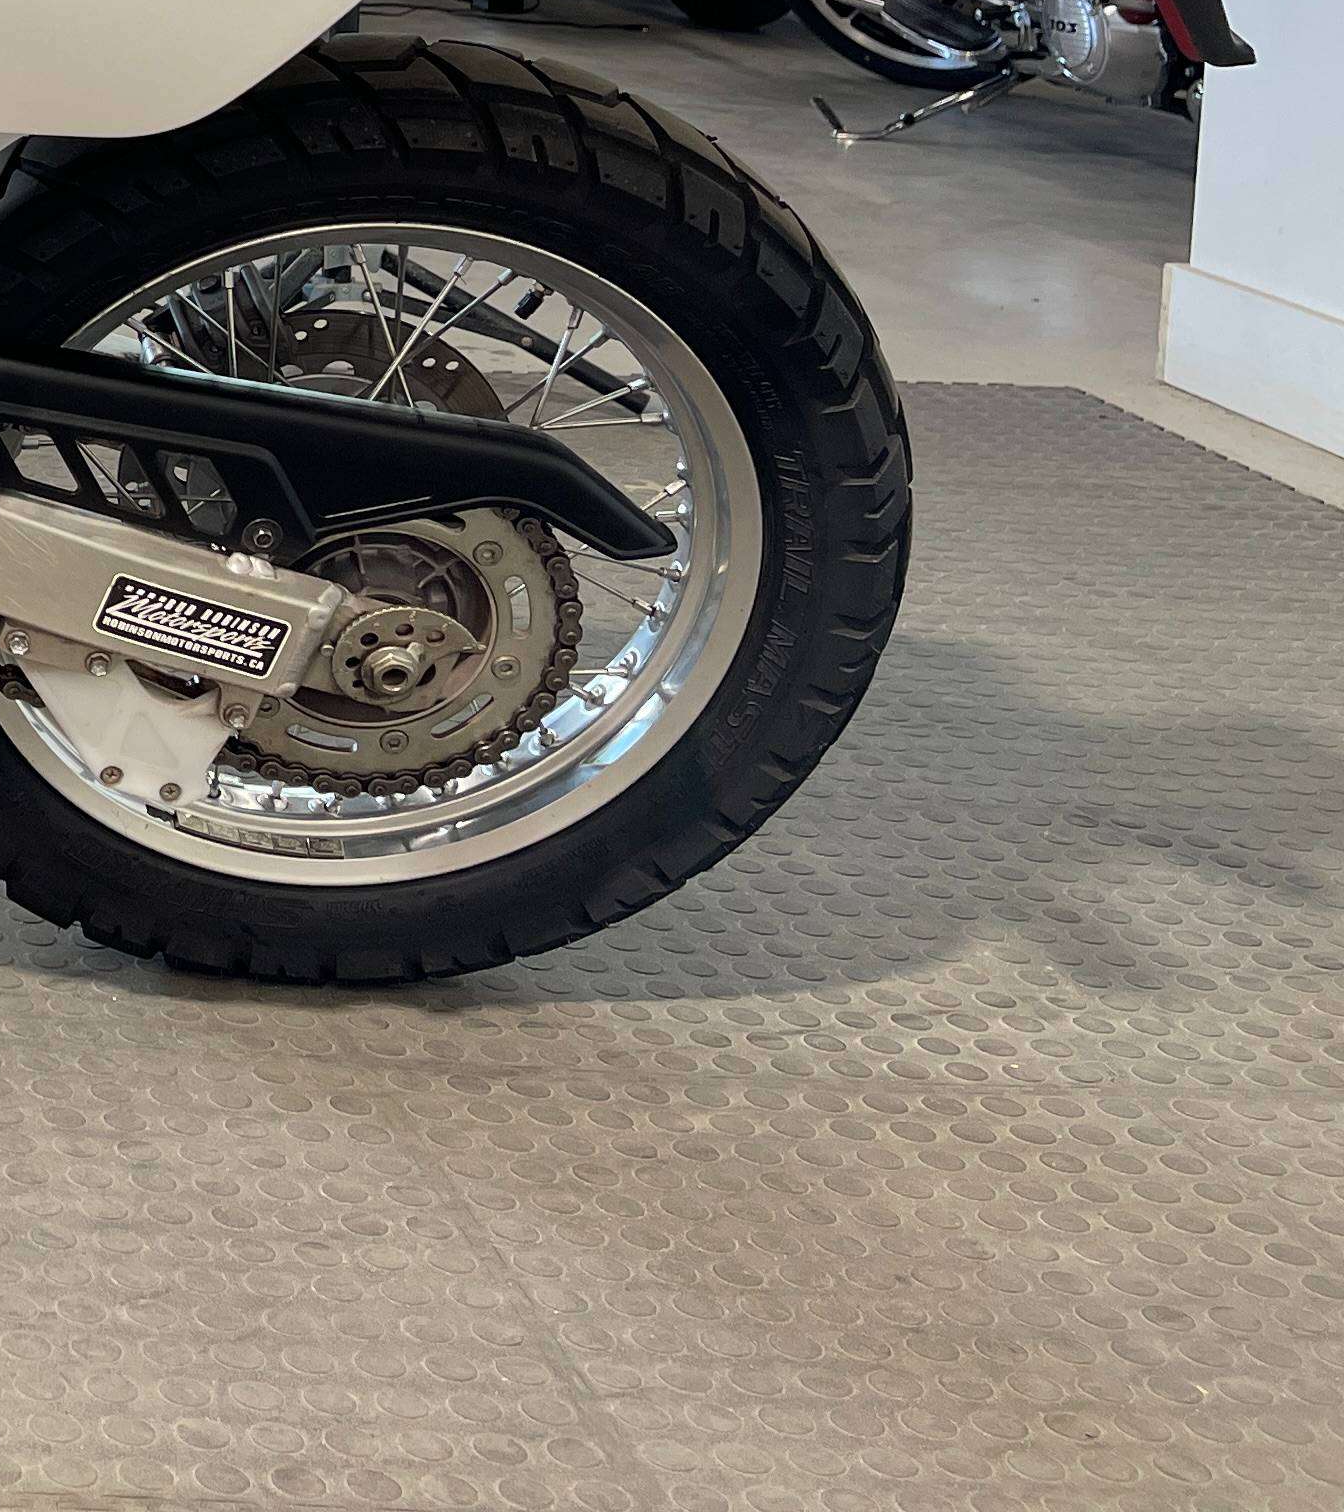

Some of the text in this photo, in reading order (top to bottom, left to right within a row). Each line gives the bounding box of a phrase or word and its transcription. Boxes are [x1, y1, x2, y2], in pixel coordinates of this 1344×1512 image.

[774, 450, 815, 602] TRAIL
[101, 615, 265, 671] ROBINSONMOTORSPORTS.CA
[105, 593, 276, 652] Motorsports
[199, 607, 282, 641] ROBINSON
